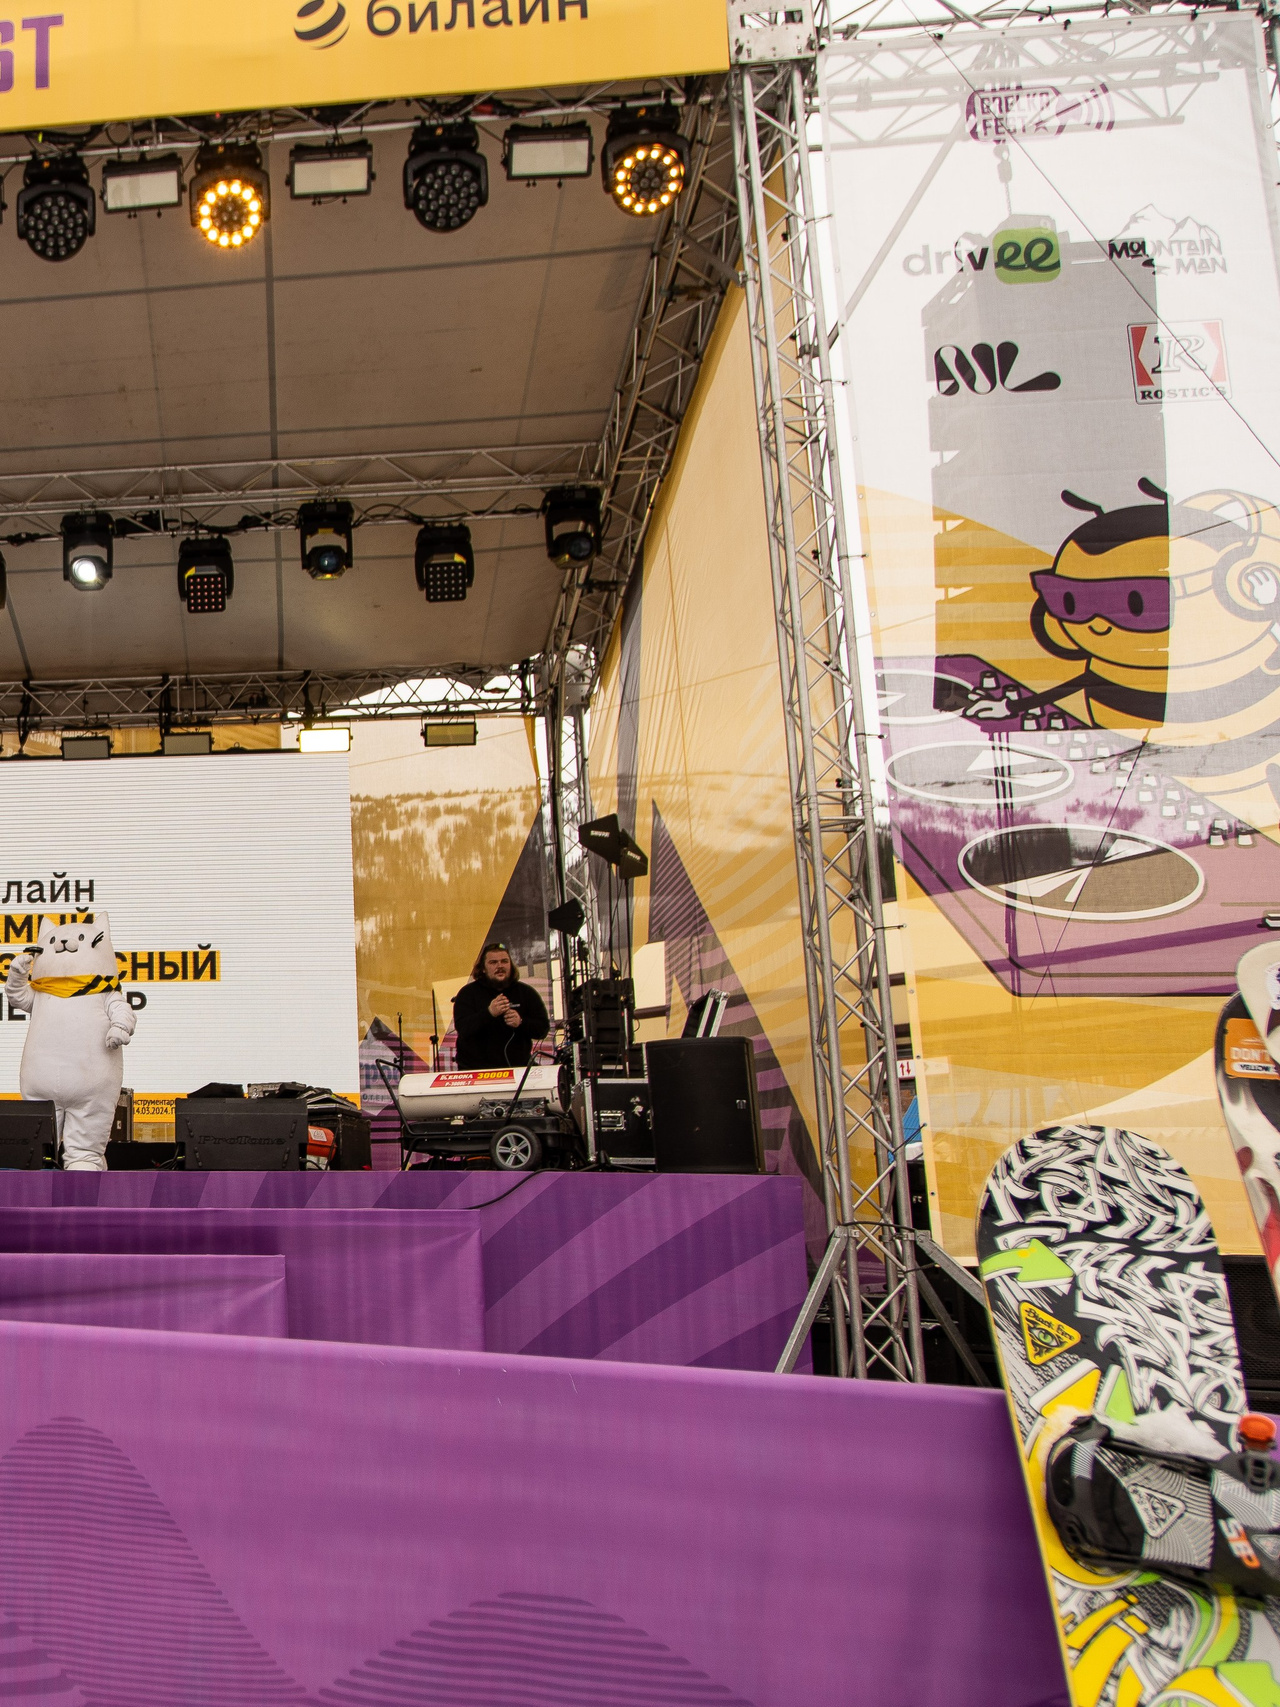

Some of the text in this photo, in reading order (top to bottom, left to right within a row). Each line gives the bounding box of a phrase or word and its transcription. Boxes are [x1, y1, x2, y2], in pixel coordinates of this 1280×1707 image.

[366, 0, 590, 36] билайн
[980, 90, 1051, 116] GRELKA
[982, 116, 1029, 137] FEST
[902, 232, 1061, 277] drivee
[1174, 256, 1229, 276] MAN
[476, 1070, 510, 1080] 30000
[133, 1099, 176, 1107] нструментар
